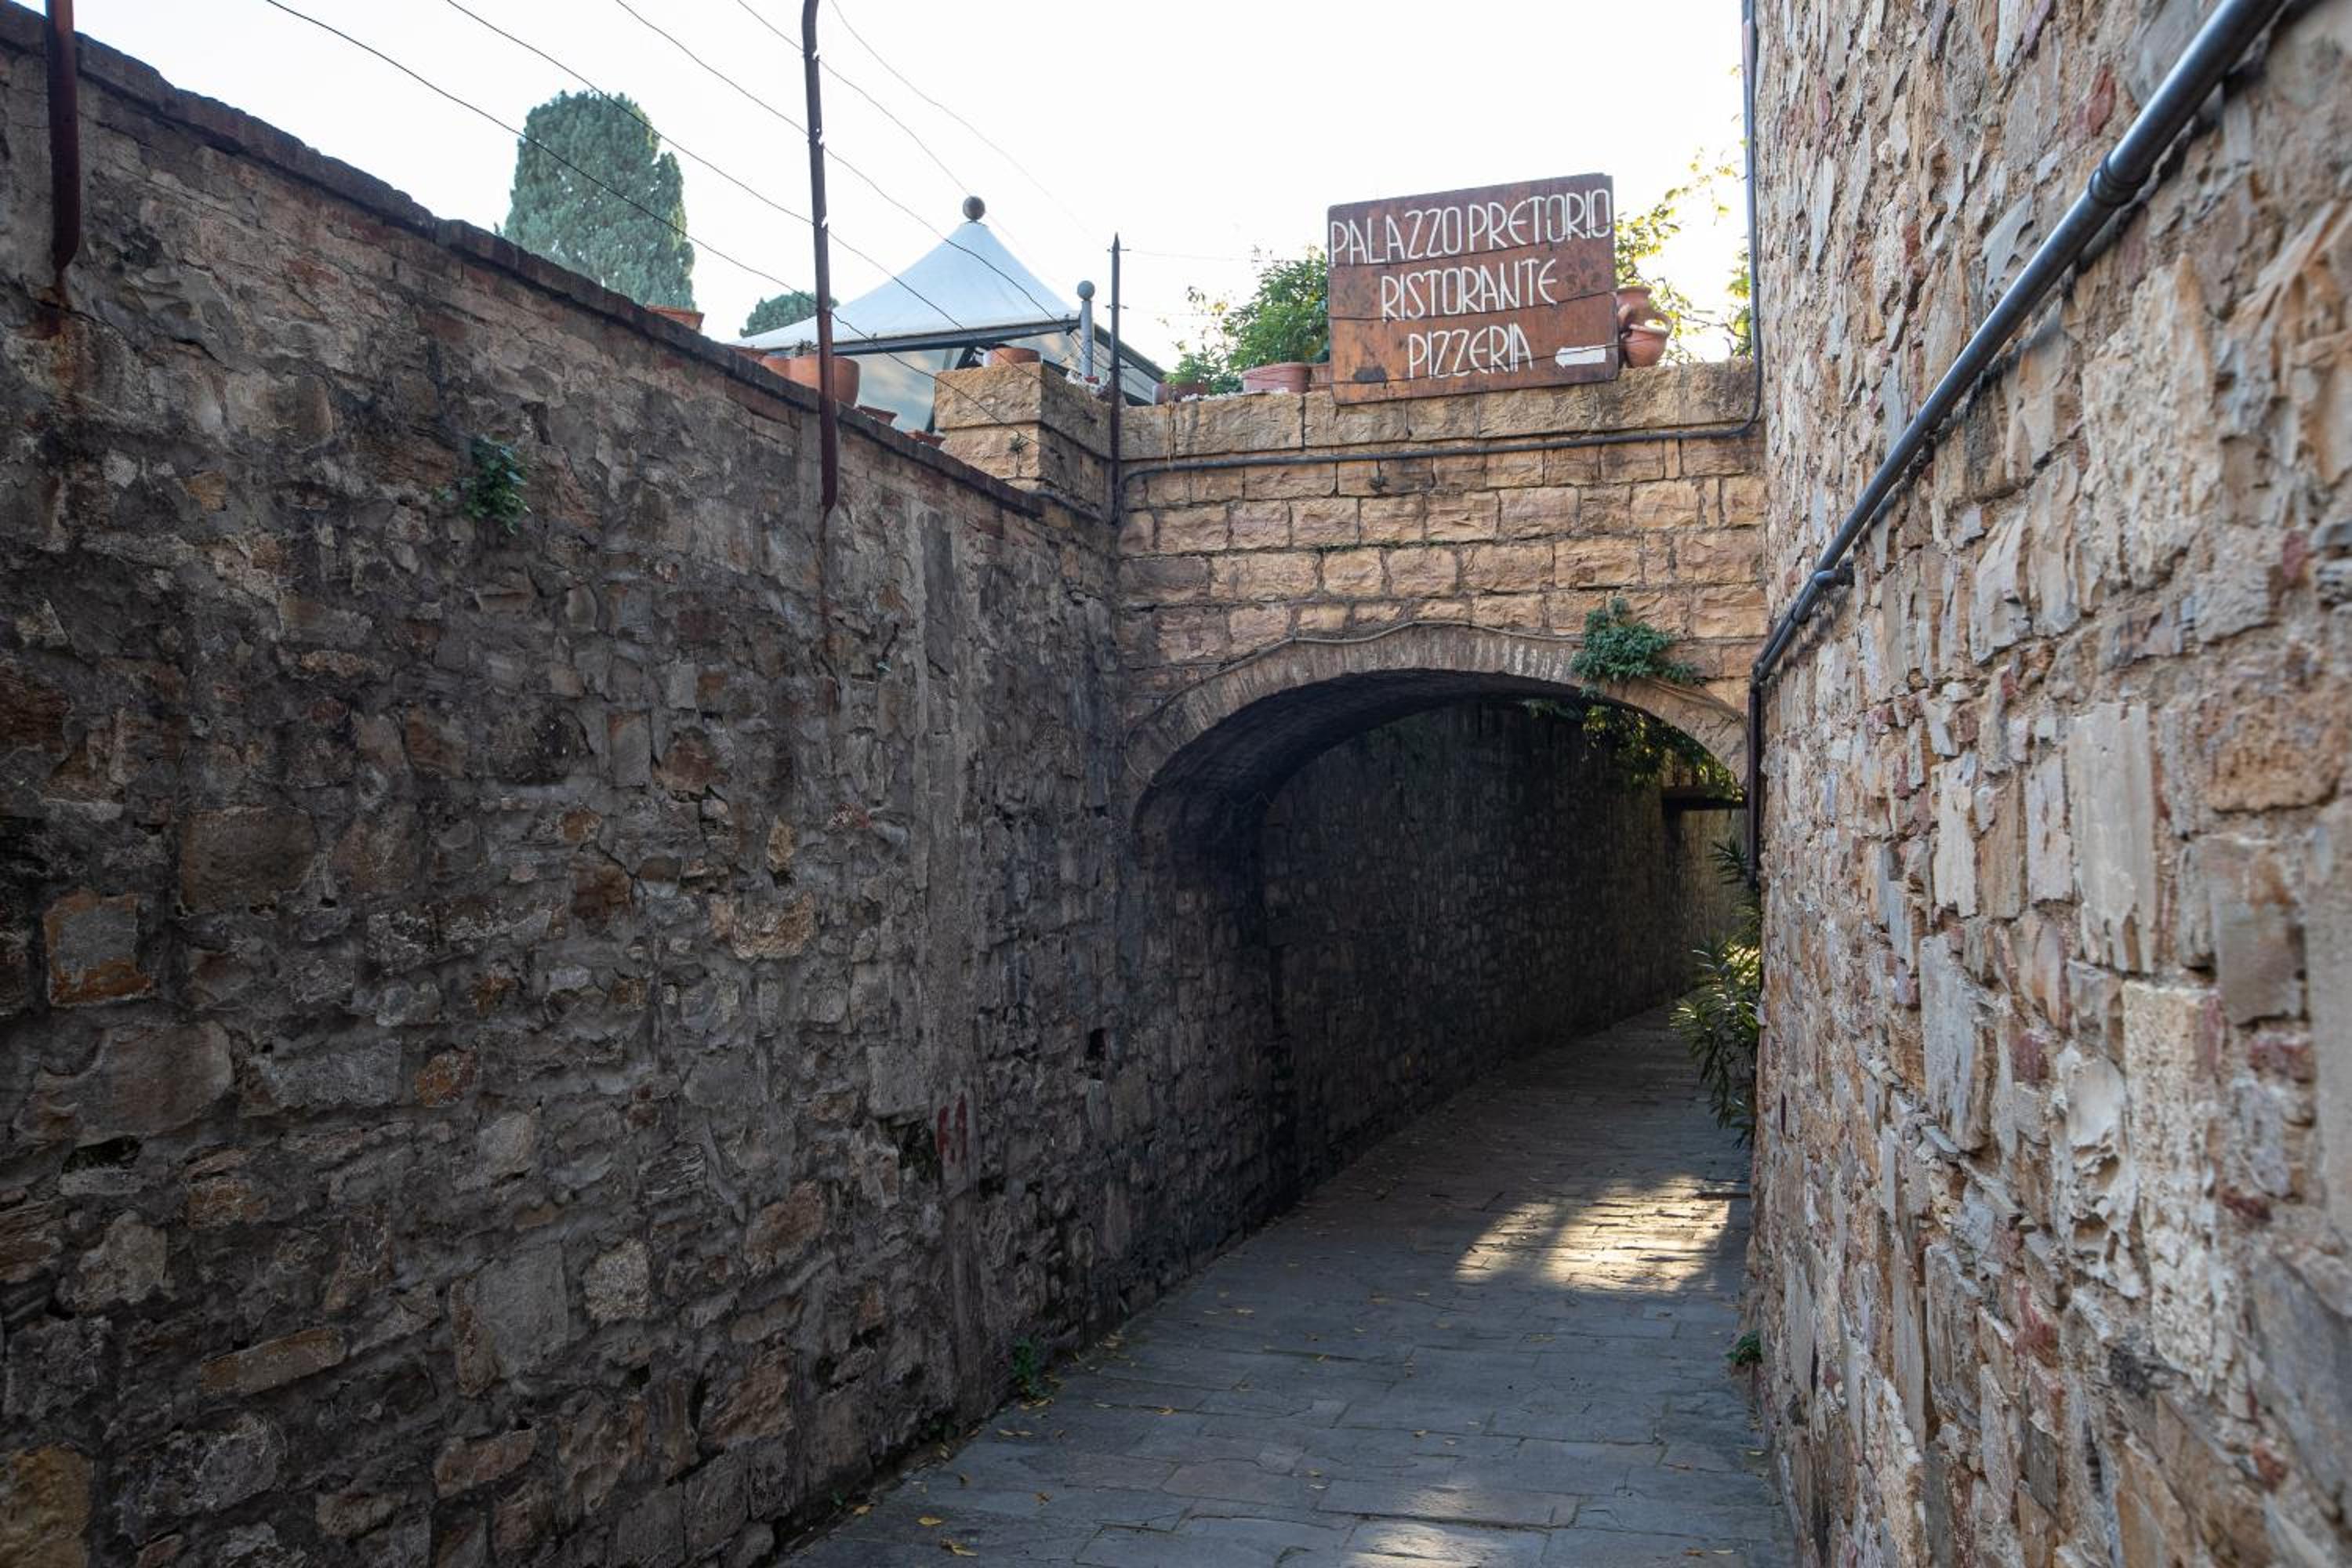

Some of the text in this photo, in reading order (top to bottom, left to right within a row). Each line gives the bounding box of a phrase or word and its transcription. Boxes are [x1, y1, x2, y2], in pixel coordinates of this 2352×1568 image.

[1330, 188, 1611, 267] PALAZZO PRETORIO
[1381, 258, 1557, 321] RISTORANTE
[1409, 322, 1533, 379] PIZZERIA
